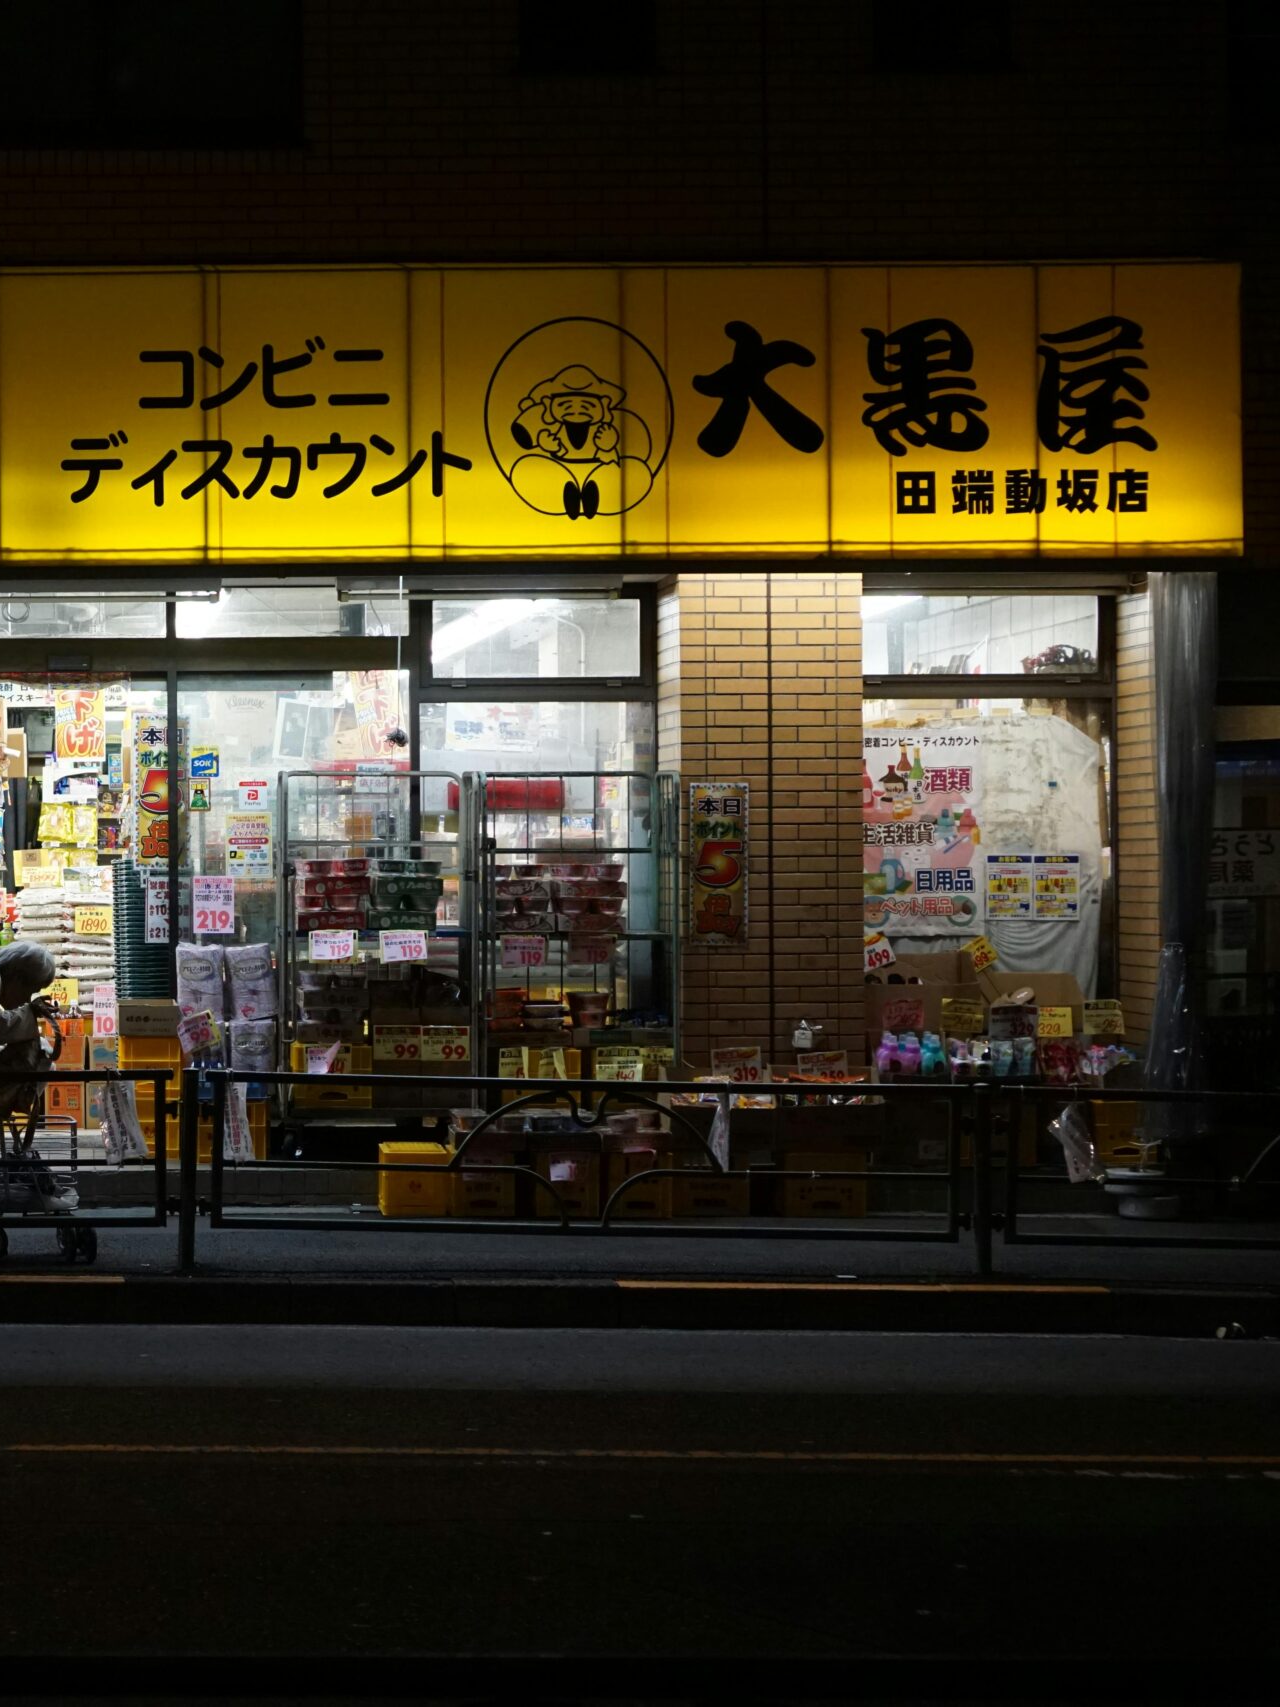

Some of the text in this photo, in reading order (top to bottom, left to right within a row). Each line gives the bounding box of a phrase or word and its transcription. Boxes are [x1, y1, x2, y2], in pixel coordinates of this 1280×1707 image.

[138, 337, 390, 410] コンビニ
[691, 316, 1160, 457] 大黒屋
[60, 432, 472, 506] ディスカウント
[895, 467, 1148, 515] 田端動坂店
[923, 765, 972, 794] 酒類
[698, 797, 741, 815] 本日
[694, 841, 745, 887] 5
[914, 868, 975, 893] 日用品
[880, 897, 956, 916] ペット用品
[80, 918, 108, 932] 1890
[196, 910, 230, 929] 219
[329, 943, 351, 957] 119
[400, 944, 424, 957] 119
[519, 951, 542, 964] 119
[868, 949, 891, 968] 499
[394, 1044, 419, 1058] 99
[441, 1044, 467, 1059] 99
[733, 1067, 759, 1082] 319
